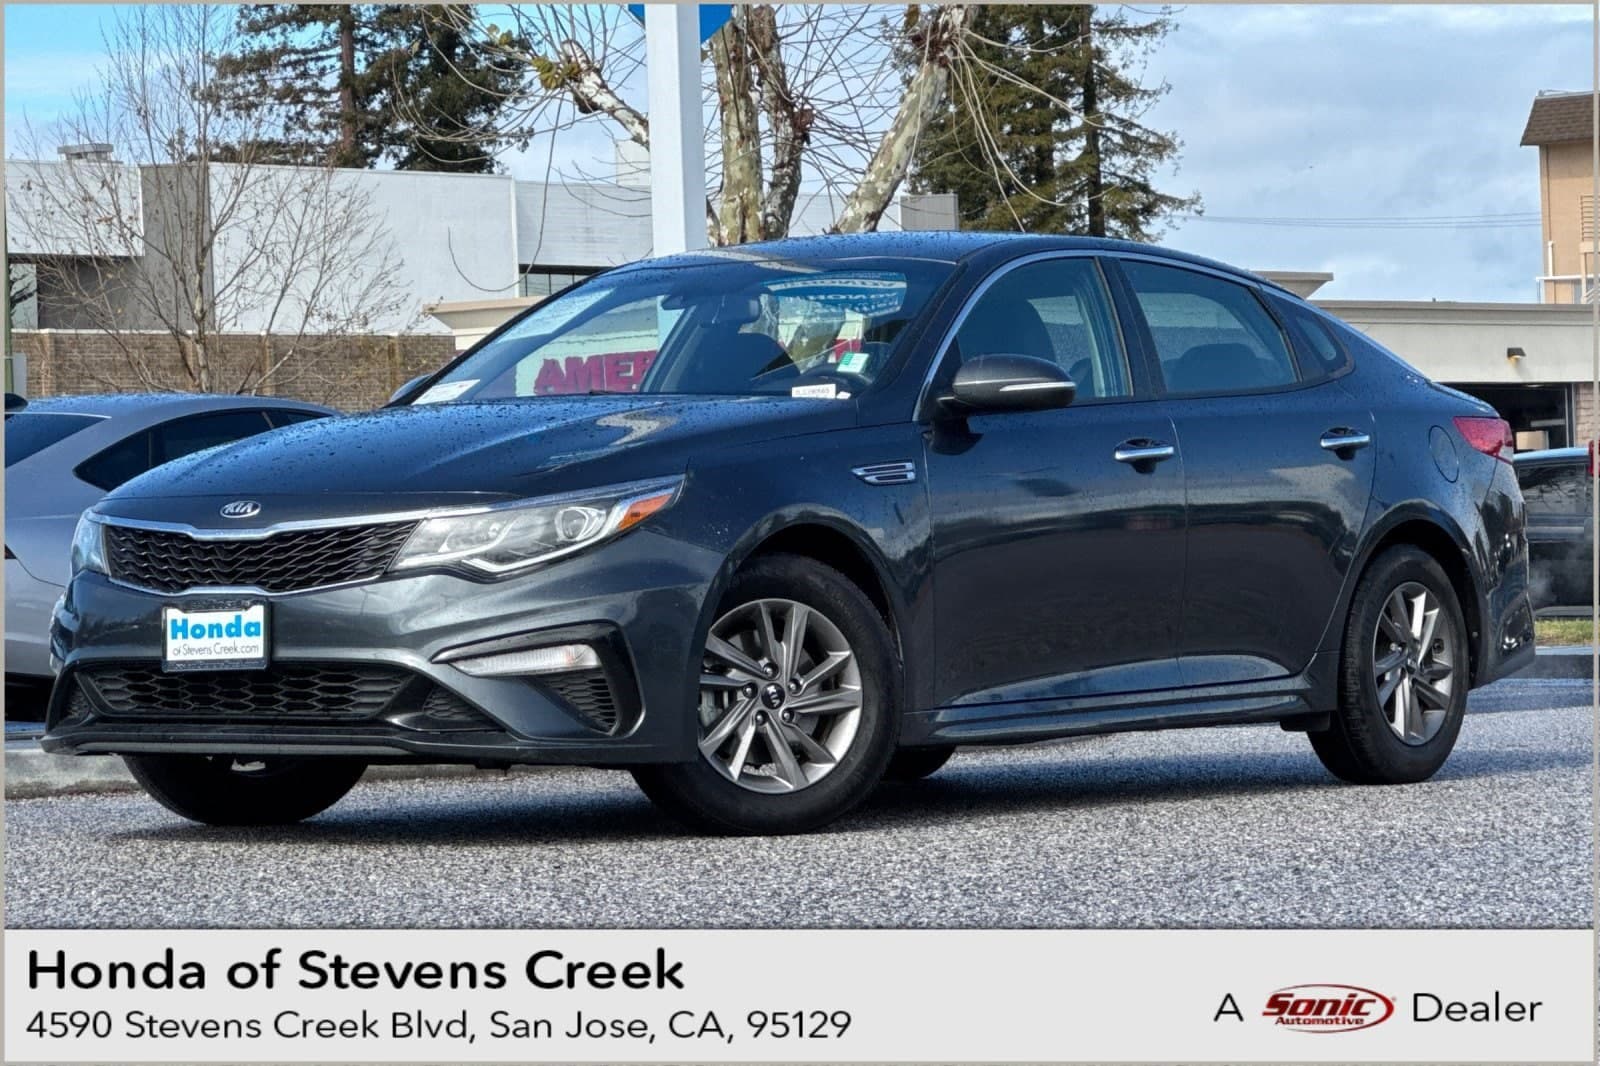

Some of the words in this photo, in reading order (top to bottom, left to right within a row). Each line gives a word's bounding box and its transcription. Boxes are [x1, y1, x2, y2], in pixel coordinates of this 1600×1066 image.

[224, 502, 253, 514] KIA
[170, 614, 261, 640] Honda
[172, 646, 182, 656] of
[182, 643, 212, 656] Stevens
